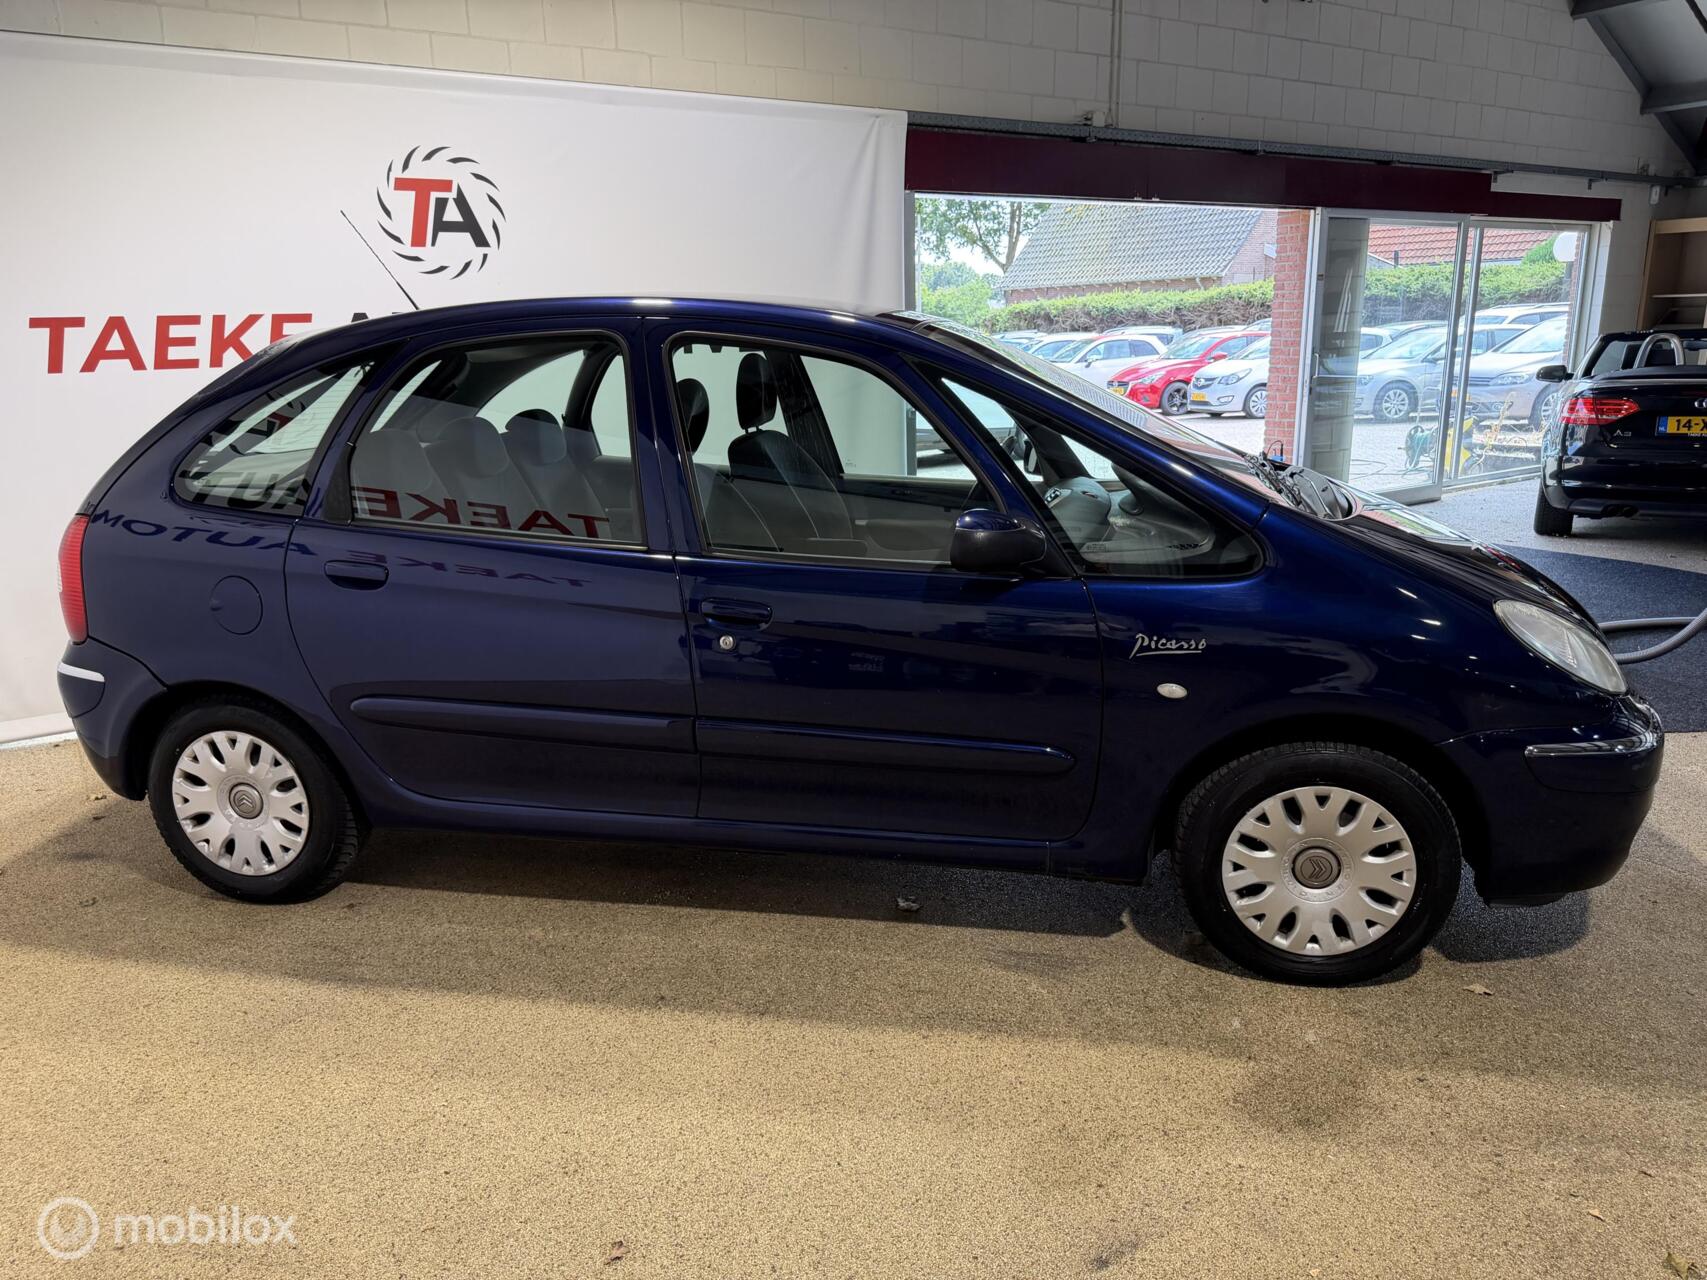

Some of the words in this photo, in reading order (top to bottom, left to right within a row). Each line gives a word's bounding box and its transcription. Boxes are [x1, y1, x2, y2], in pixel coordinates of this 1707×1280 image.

[394, 177, 491, 248] TA
[1613, 429, 1632, 437] A3
[1129, 633, 1207, 660] Picasso
